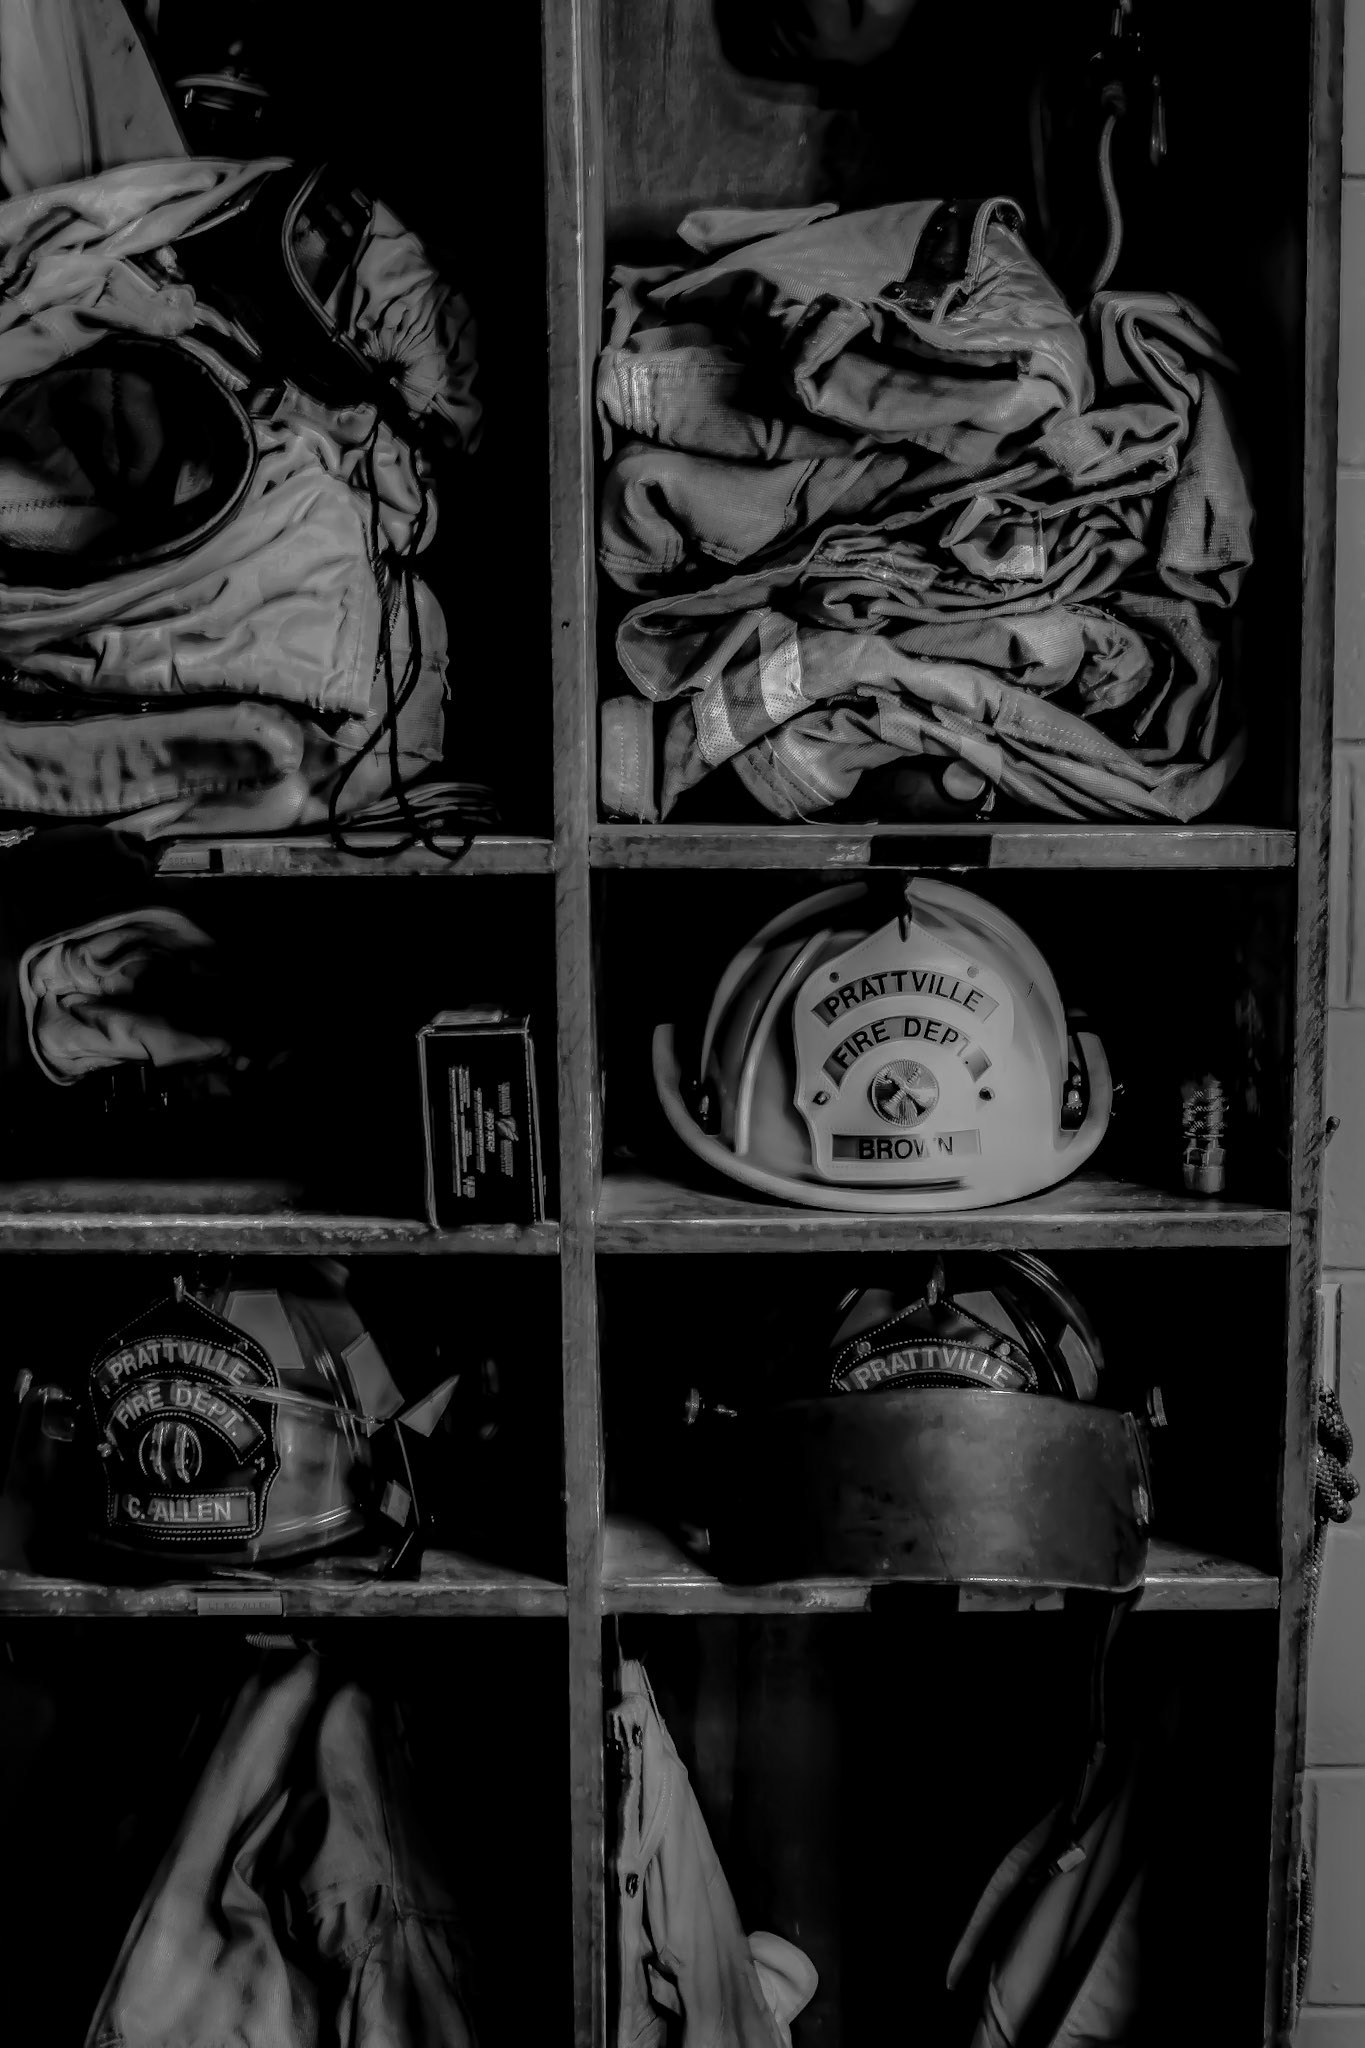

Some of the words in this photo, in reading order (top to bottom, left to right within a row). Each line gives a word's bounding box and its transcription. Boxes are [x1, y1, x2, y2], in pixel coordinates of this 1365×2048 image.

[823, 972, 984, 1018] PRATTVILLE
[831, 1021, 891, 1070] FIRE
[108, 1342, 250, 1385] PRATTVILLE
[852, 1346, 1013, 1391] PRATTVILLE
[115, 1386, 165, 1430] FIRE
[174, 1386, 245, 1438] DEPT.
[127, 1496, 146, 1520] C.
[152, 1501, 232, 1522] ALLEN
